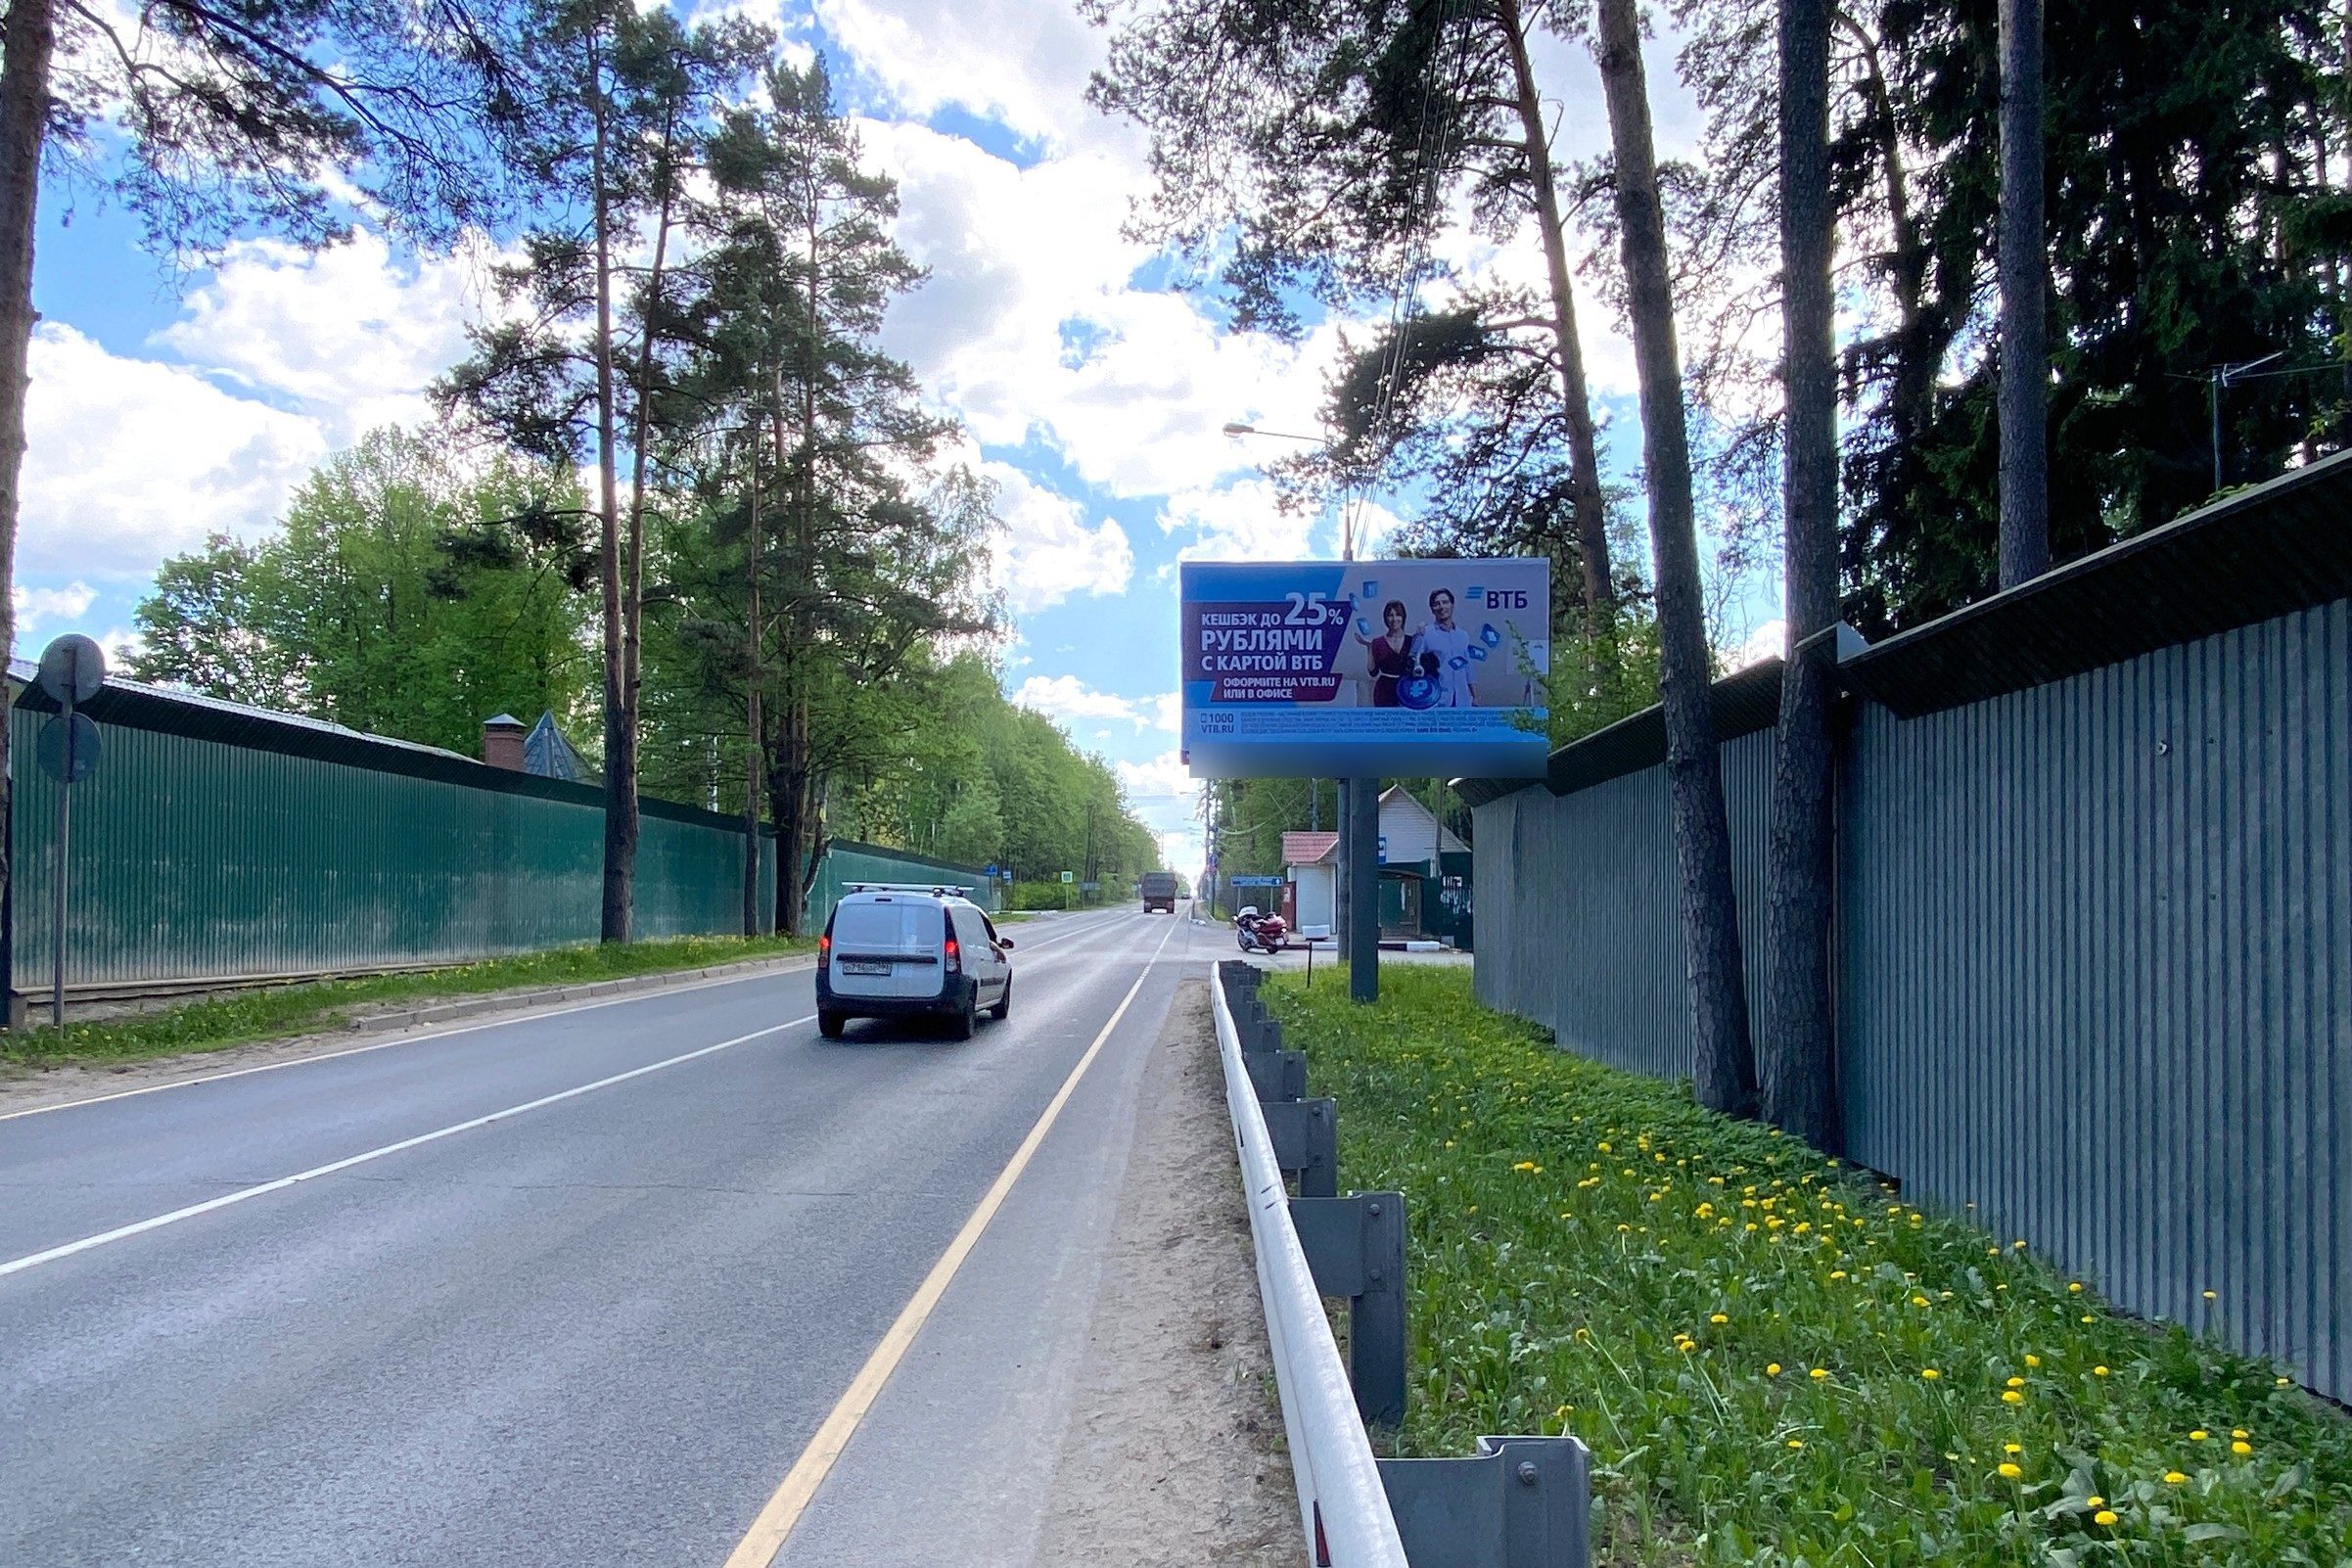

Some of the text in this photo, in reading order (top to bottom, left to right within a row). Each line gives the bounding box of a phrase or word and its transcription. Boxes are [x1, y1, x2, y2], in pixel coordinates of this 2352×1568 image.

[1487, 590, 1528, 609] ВТБ
[1202, 592, 1344, 627] КЕШБЭК ДО 25%
[1201, 629, 1322, 651] РУБЛЯМИ
[1201, 652, 1322, 670] С КАРТОЙ ВТБ
[1223, 677, 1335, 687] ОФОРМИТЕ НА VTB.RU
[1223, 688, 1292, 699] ИЛИ В ОФИСЕ
[1210, 713, 1234, 723] 1000
[1201, 724, 1234, 733] VTB.RU
